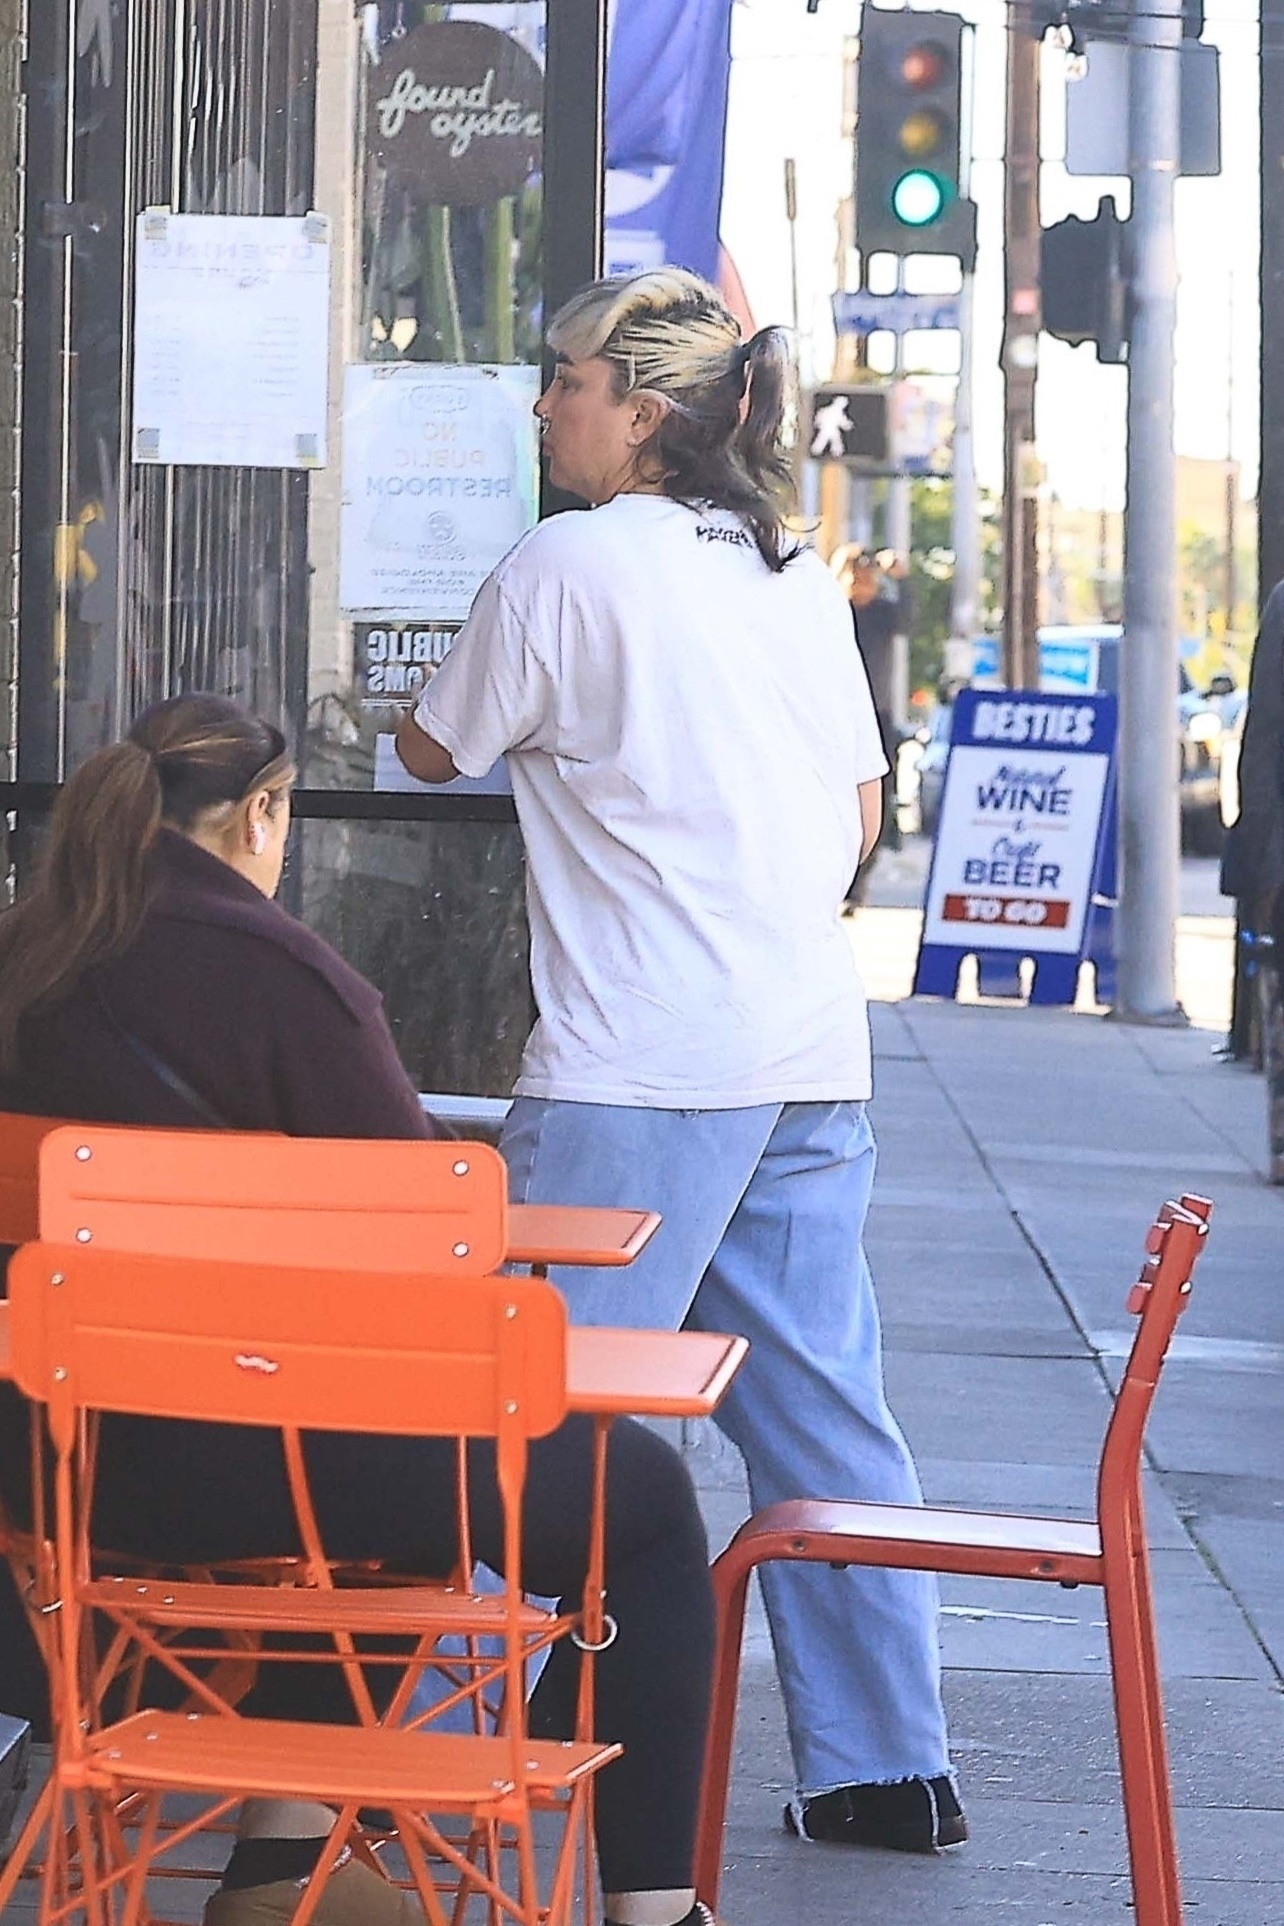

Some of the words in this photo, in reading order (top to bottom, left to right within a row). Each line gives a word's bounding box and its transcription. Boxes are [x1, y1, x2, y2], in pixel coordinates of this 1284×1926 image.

[376, 68, 495, 139] found
[430, 99, 543, 158] oyster
[977, 784, 1072, 815] WINE
[963, 859, 1061, 889] BEER
[965, 897, 1002, 922] TO
[1002, 900, 1048, 925] GO
